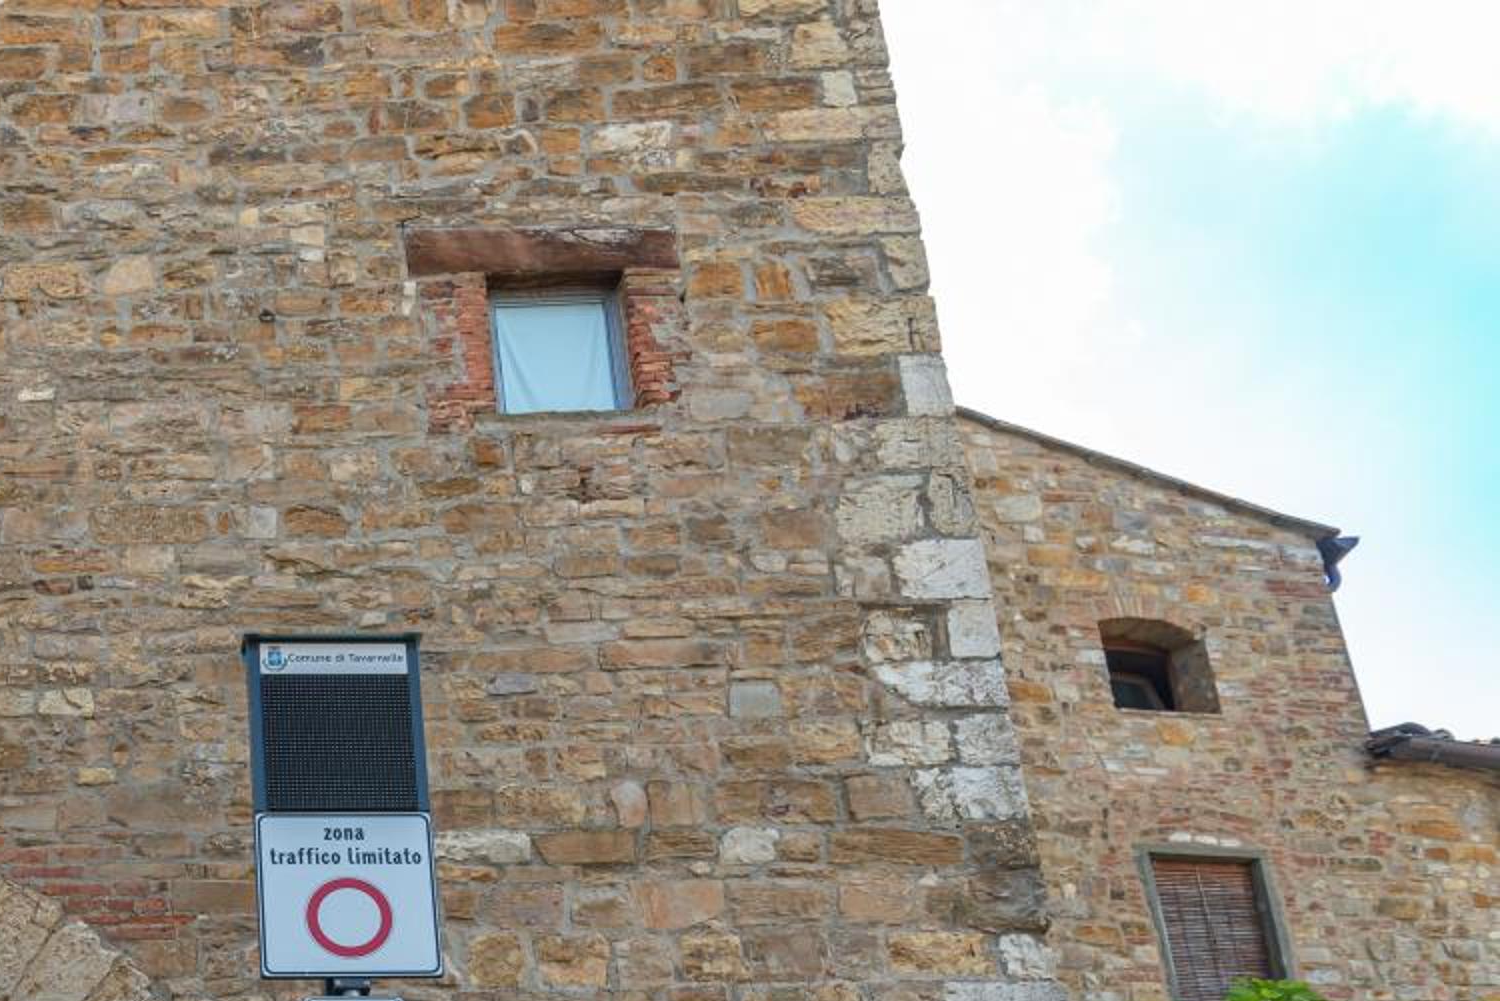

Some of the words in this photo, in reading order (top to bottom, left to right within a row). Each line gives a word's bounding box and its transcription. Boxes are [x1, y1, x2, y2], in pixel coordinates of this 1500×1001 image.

[335, 653, 345, 662] di
[324, 827, 365, 841] zona
[270, 848, 341, 865] traffico
[347, 848, 422, 865] limitato
